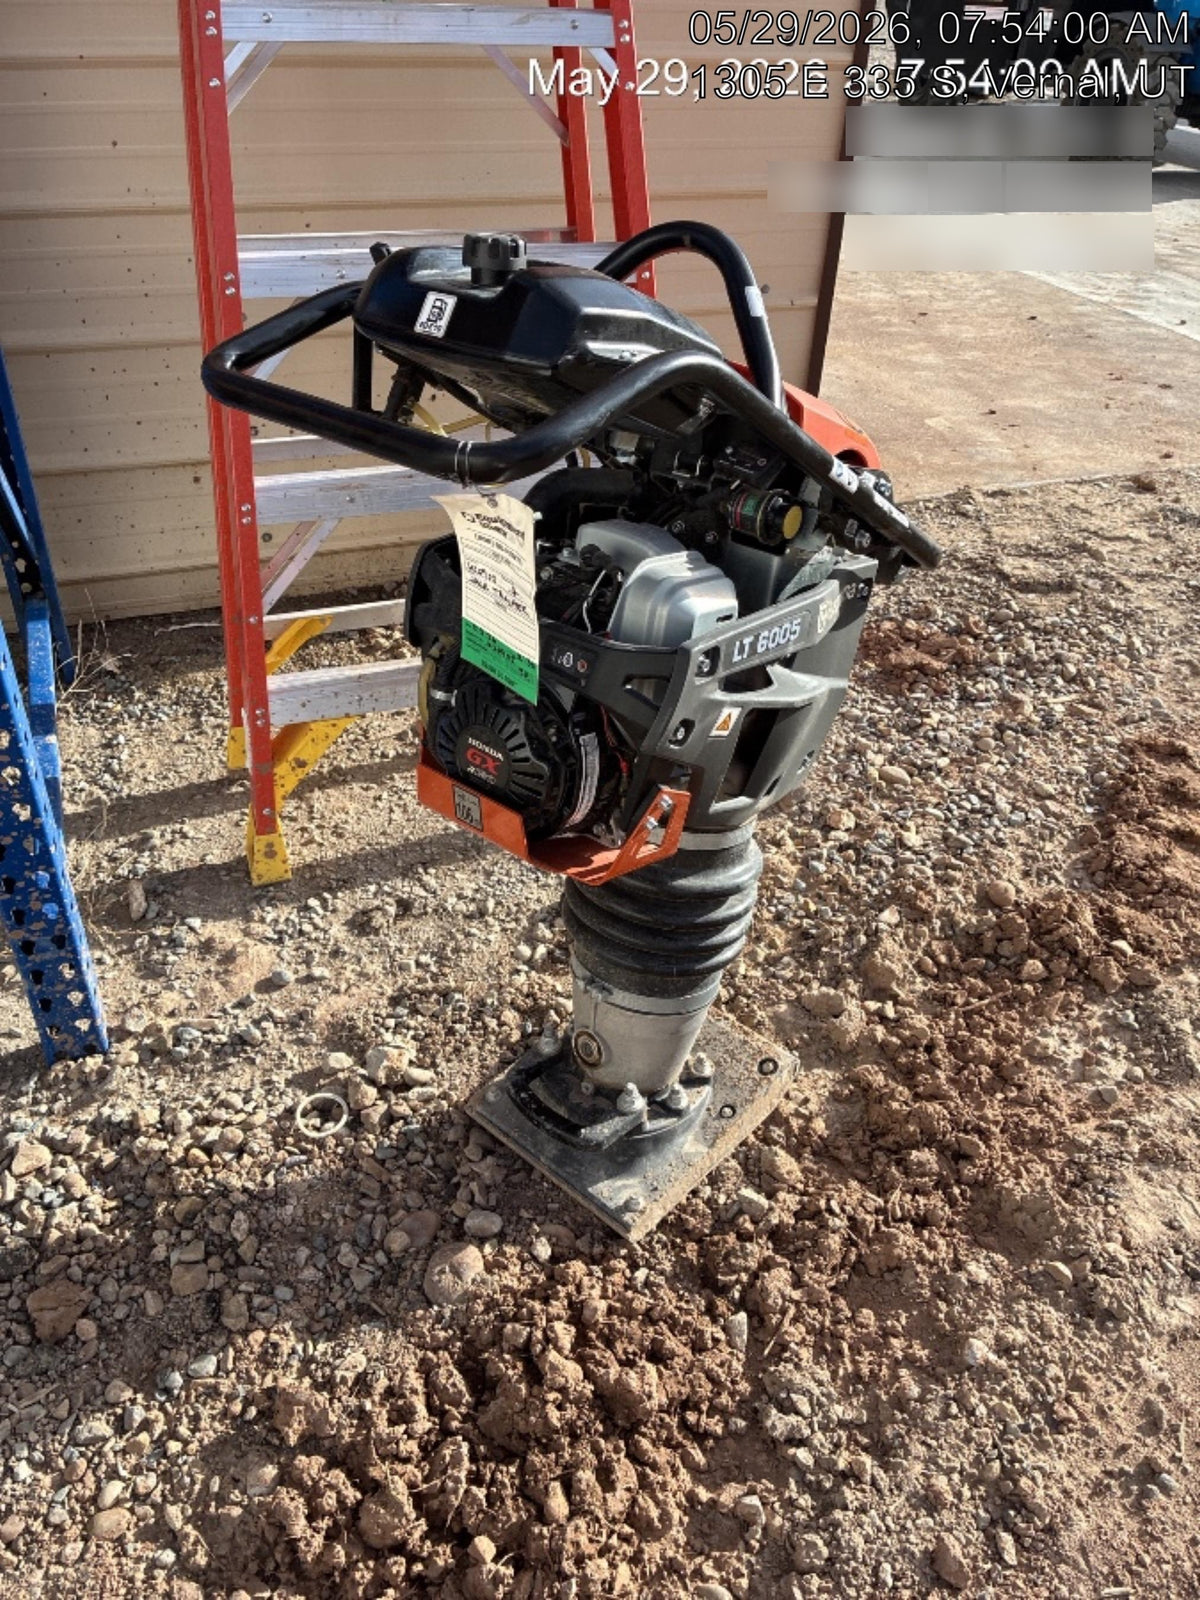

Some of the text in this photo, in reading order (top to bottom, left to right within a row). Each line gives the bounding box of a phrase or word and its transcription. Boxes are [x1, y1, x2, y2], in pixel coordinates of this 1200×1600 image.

[732, 617, 802, 663] LT 6005
[465, 747, 502, 774] GX
[468, 737, 504, 762] HONDA
